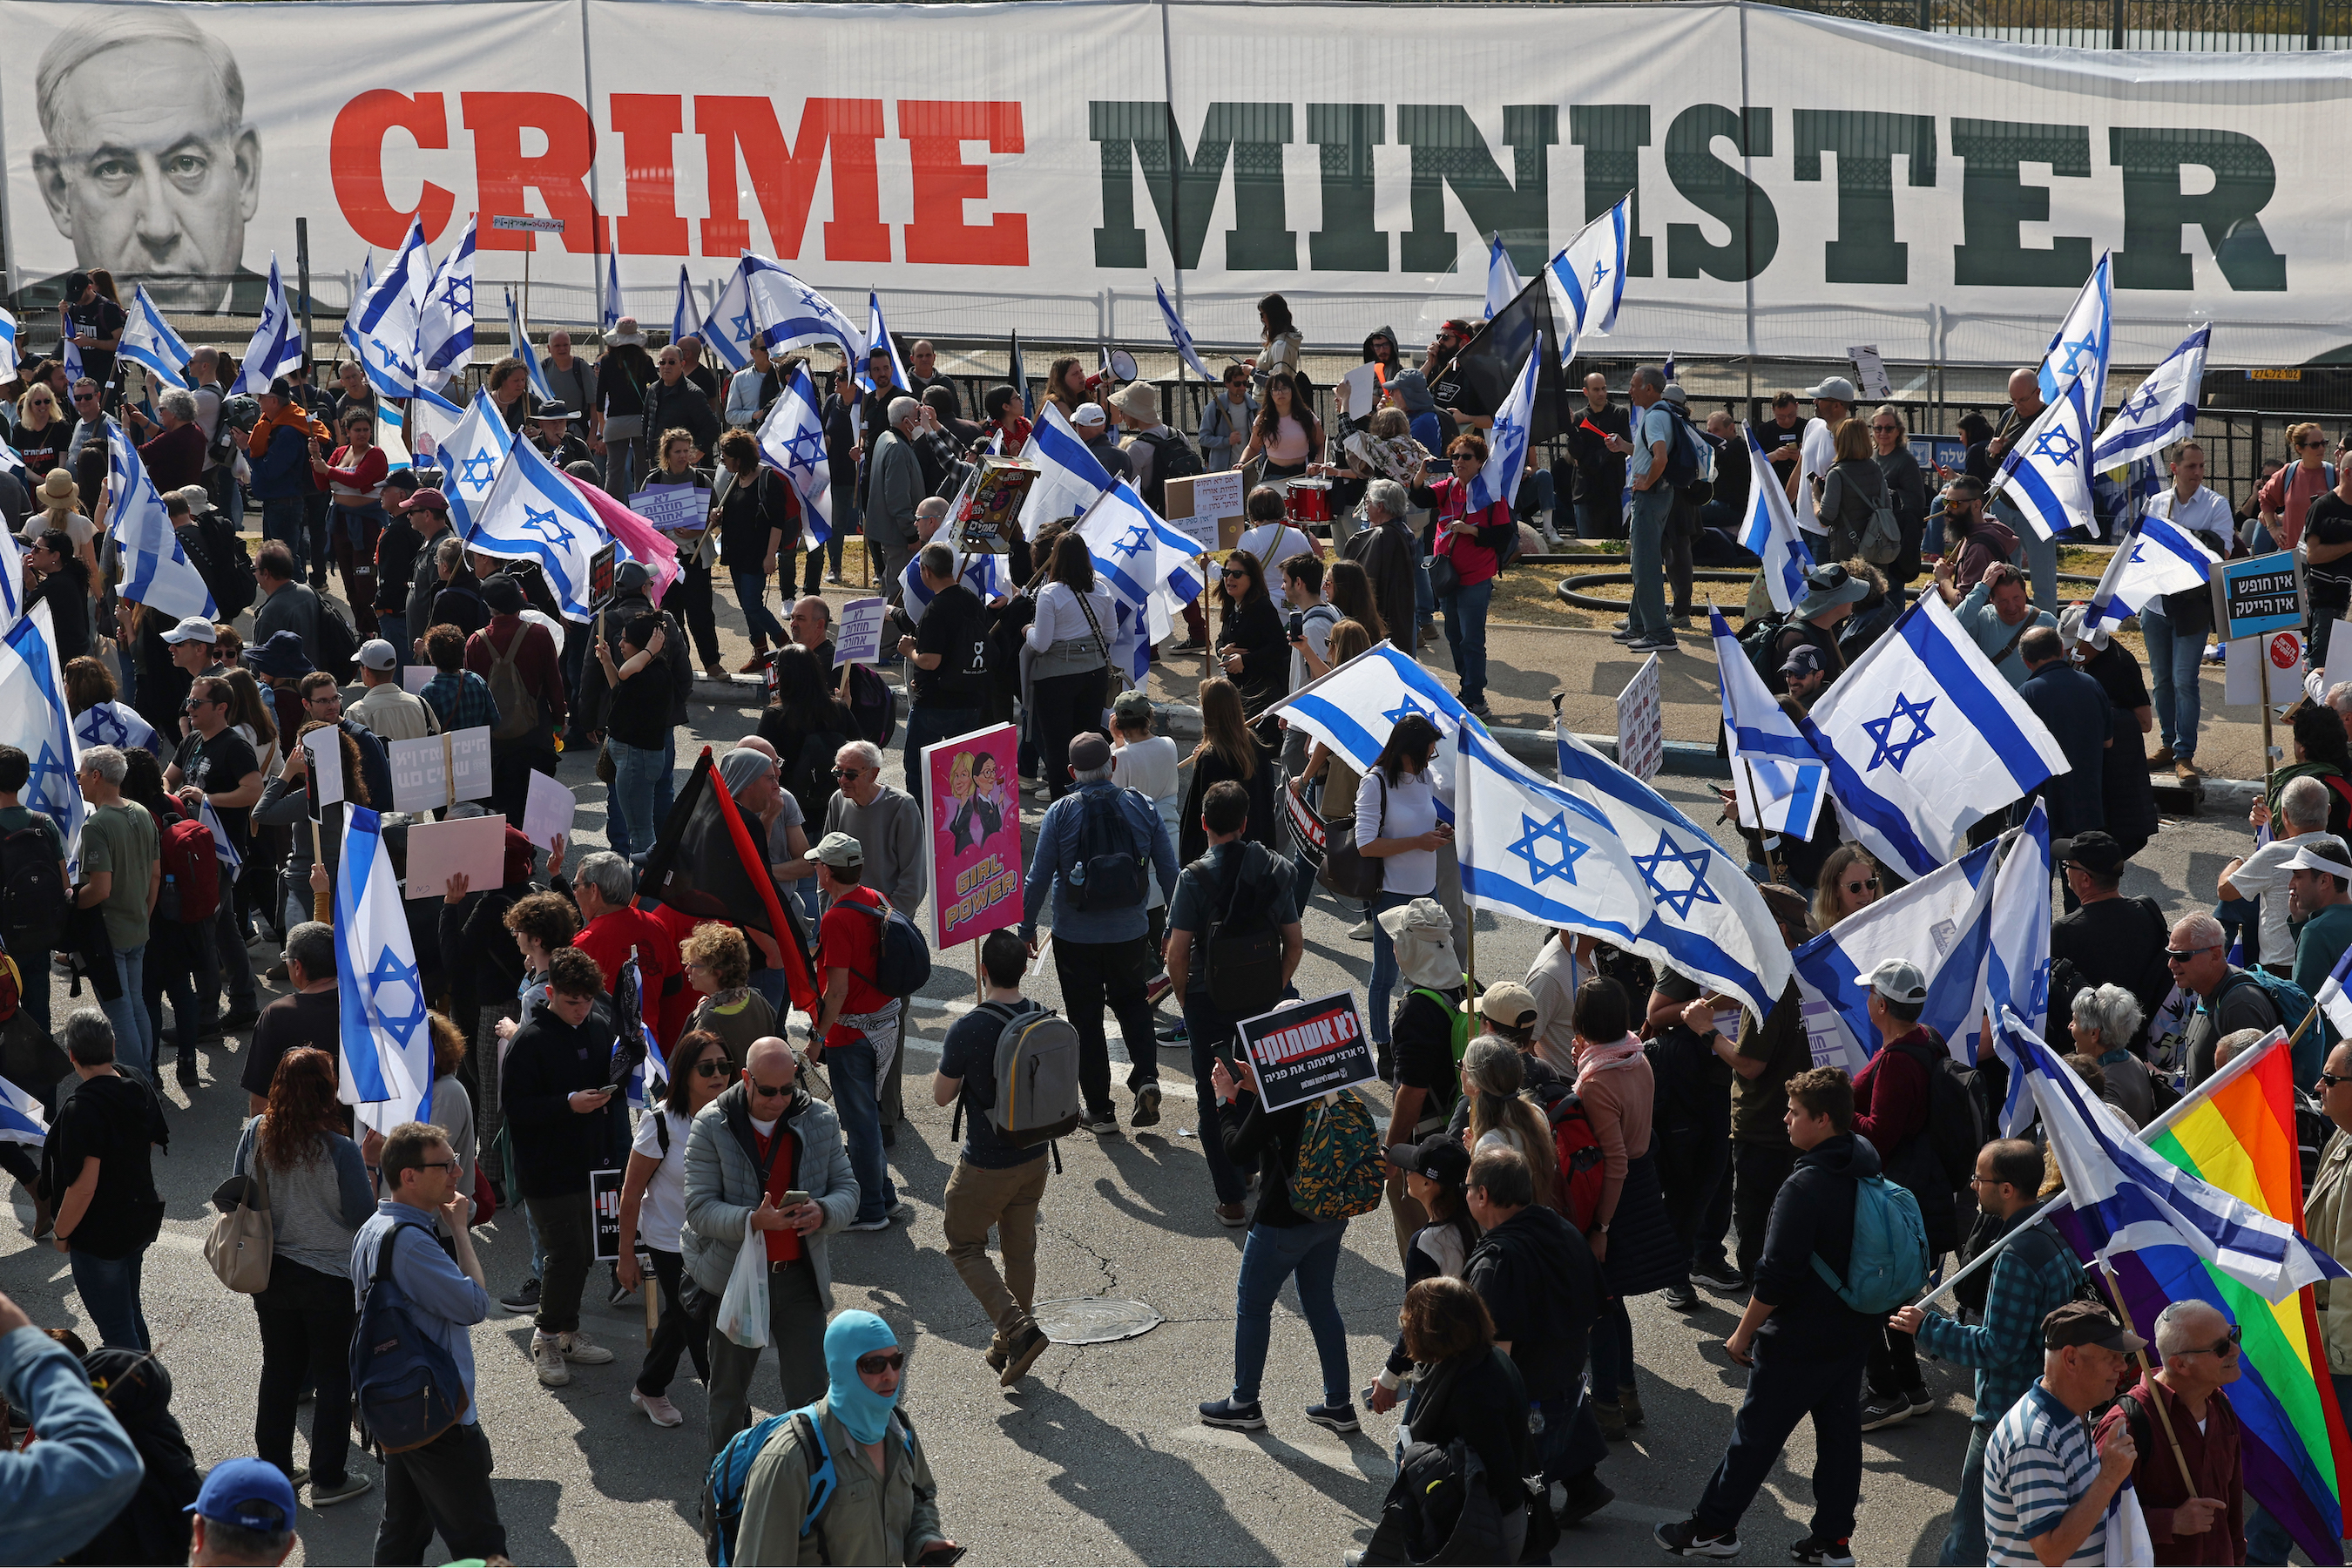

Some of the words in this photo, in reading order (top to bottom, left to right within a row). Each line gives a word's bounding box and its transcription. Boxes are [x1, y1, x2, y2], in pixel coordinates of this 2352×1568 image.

[329, 88, 1029, 267] CRIME
[1089, 100, 2287, 292] MINISTER
[1196, 479, 1212, 488] תקום
[1213, 476, 1222, 484] לא
[1220, 483, 1238, 493] להיות
[653, 493, 670, 504] לא
[645, 502, 683, 515] חוזרות
[2238, 578, 2272, 594] חופש
[2274, 574, 2294, 591] אין
[2235, 599, 2273, 617] הייטק
[2274, 597, 2295, 613] אין
[854, 608, 864, 620] לא
[845, 622, 869, 635] חוזרות
[843, 635, 868, 649] אחורה
[956, 853, 1005, 897] GIRL
[944, 869, 1018, 932] POWER
[1332, 1010, 1359, 1042] לא
[1254, 1017, 1336, 1066] אשתוק!
[1809, 1035, 1827, 1050] חוז
[1337, 1048, 1357, 1061] ארצי
[1356, 1045, 1366, 1055] כי
[1290, 1062, 1306, 1077] את
[1307, 1054, 1336, 1071] שינתה
[1264, 1069, 1288, 1084] פניה
